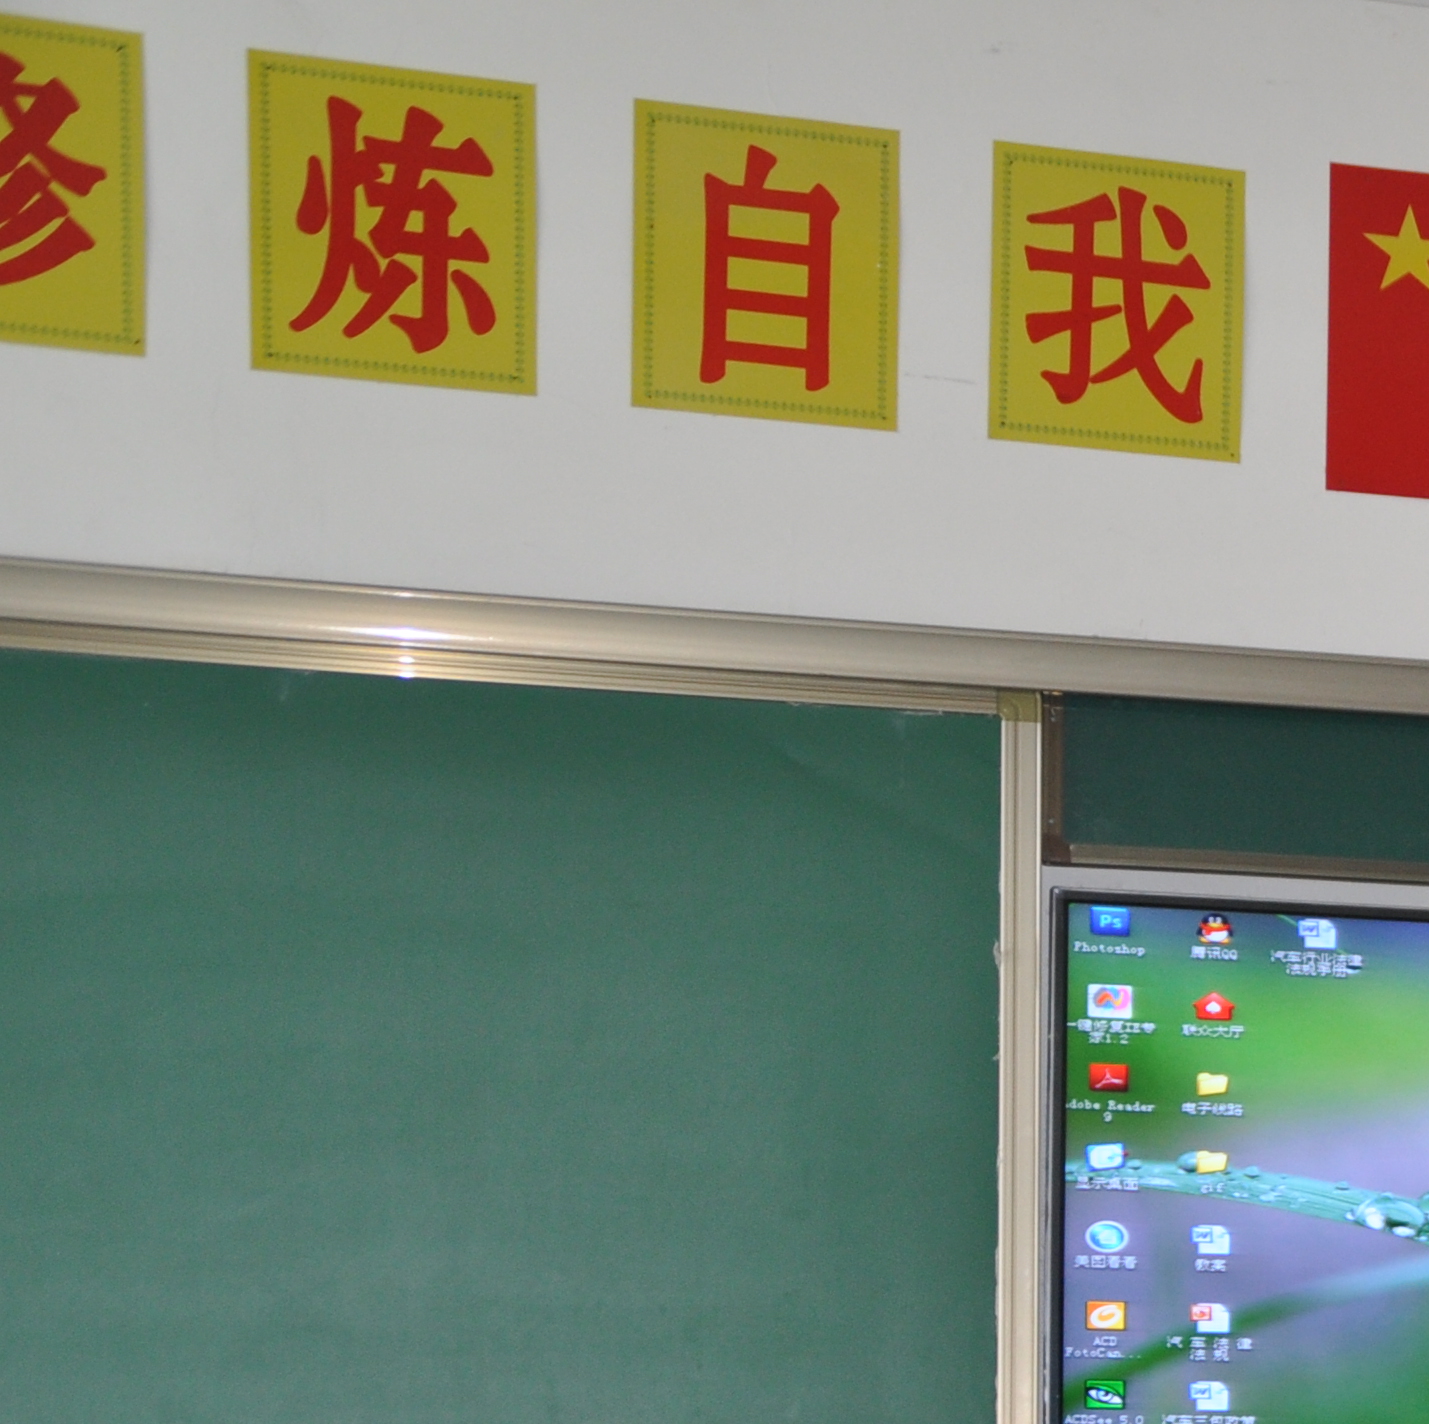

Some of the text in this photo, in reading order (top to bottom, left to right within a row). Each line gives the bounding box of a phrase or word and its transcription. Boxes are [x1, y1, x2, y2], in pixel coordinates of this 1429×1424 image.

[1099, 914, 1122, 929] Ps
[1073, 941, 1146, 957] Photoshop
[1107, 1099, 1155, 1113] Reader
[1092, 1335, 1117, 1347] ACD
